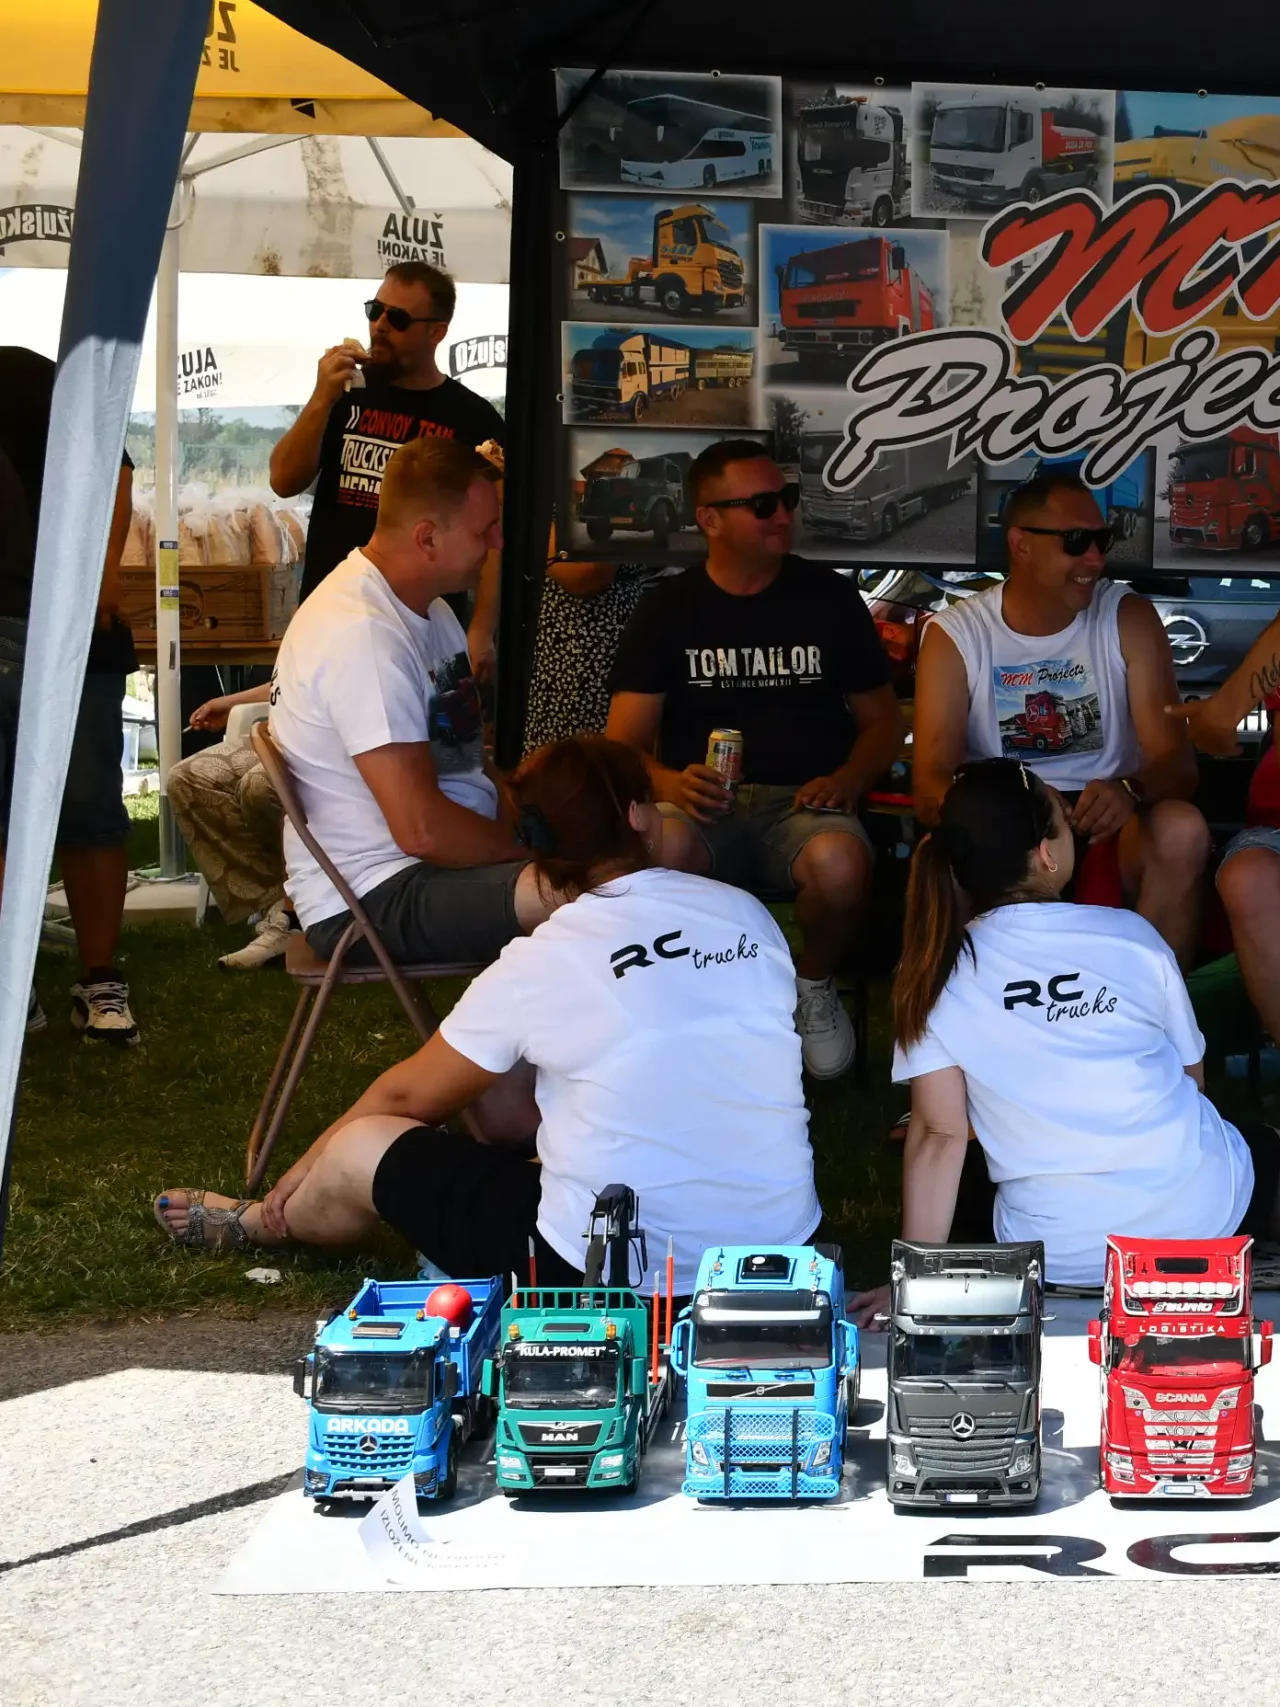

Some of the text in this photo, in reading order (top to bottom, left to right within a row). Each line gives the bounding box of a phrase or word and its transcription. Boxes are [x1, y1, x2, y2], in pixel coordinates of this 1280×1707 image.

[178, 347, 217, 377] UJA
[455, 335, 509, 373] Ožujs
[183, 371, 223, 394] ZAKON!
[358, 408, 414, 441] CONVOY
[685, 645, 822, 678] TOM TAILOR
[1037, 664, 1084, 685] Projects
[610, 929, 759, 980] RC trucks
[1003, 972, 1118, 1023] RC trucks
[1139, 1325, 1226, 1333] LOGISTIKA
[1155, 1392, 1208, 1403] SCANIA
[326, 1416, 409, 1433] ARKADA
[541, 1433, 579, 1441] MAN
[391, 1488, 420, 1549] MOLIMO
